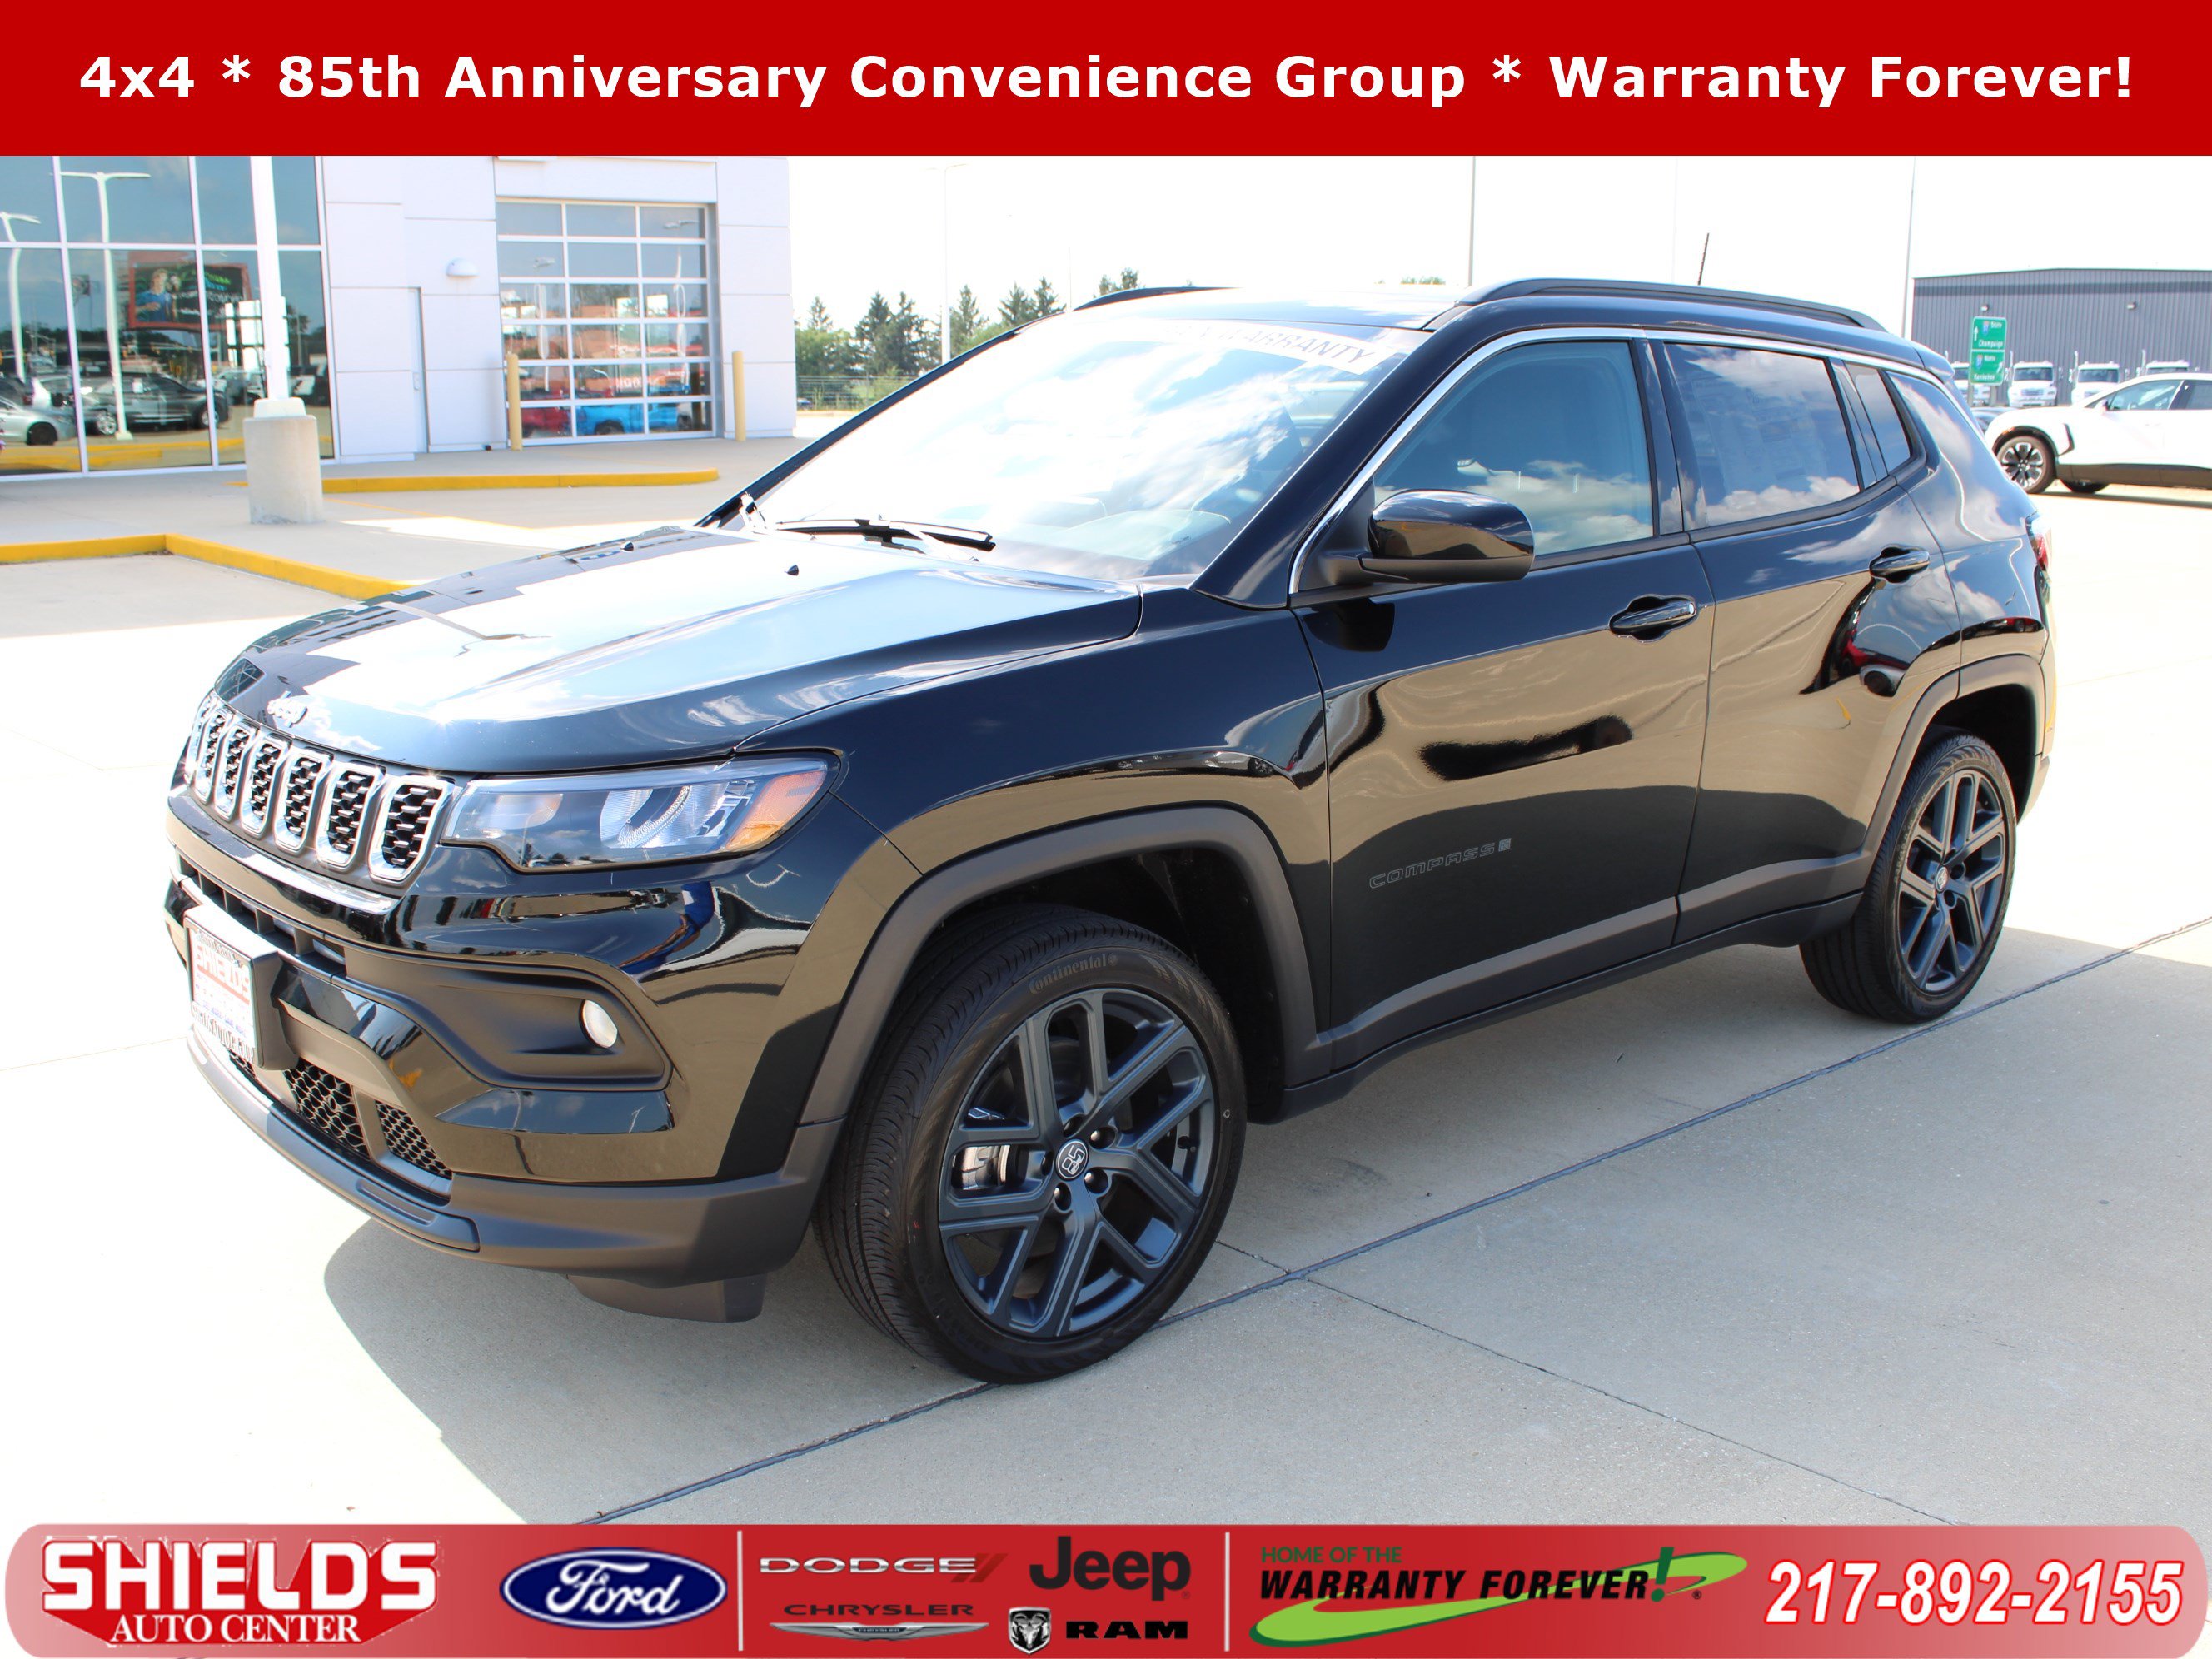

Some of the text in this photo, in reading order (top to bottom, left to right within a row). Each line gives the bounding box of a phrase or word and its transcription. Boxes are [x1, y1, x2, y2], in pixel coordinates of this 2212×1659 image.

[1218, 329, 1376, 363] ARRANTY
[1369, 843, 1496, 889] COMPASS
[1029, 954, 1107, 994] Continental
